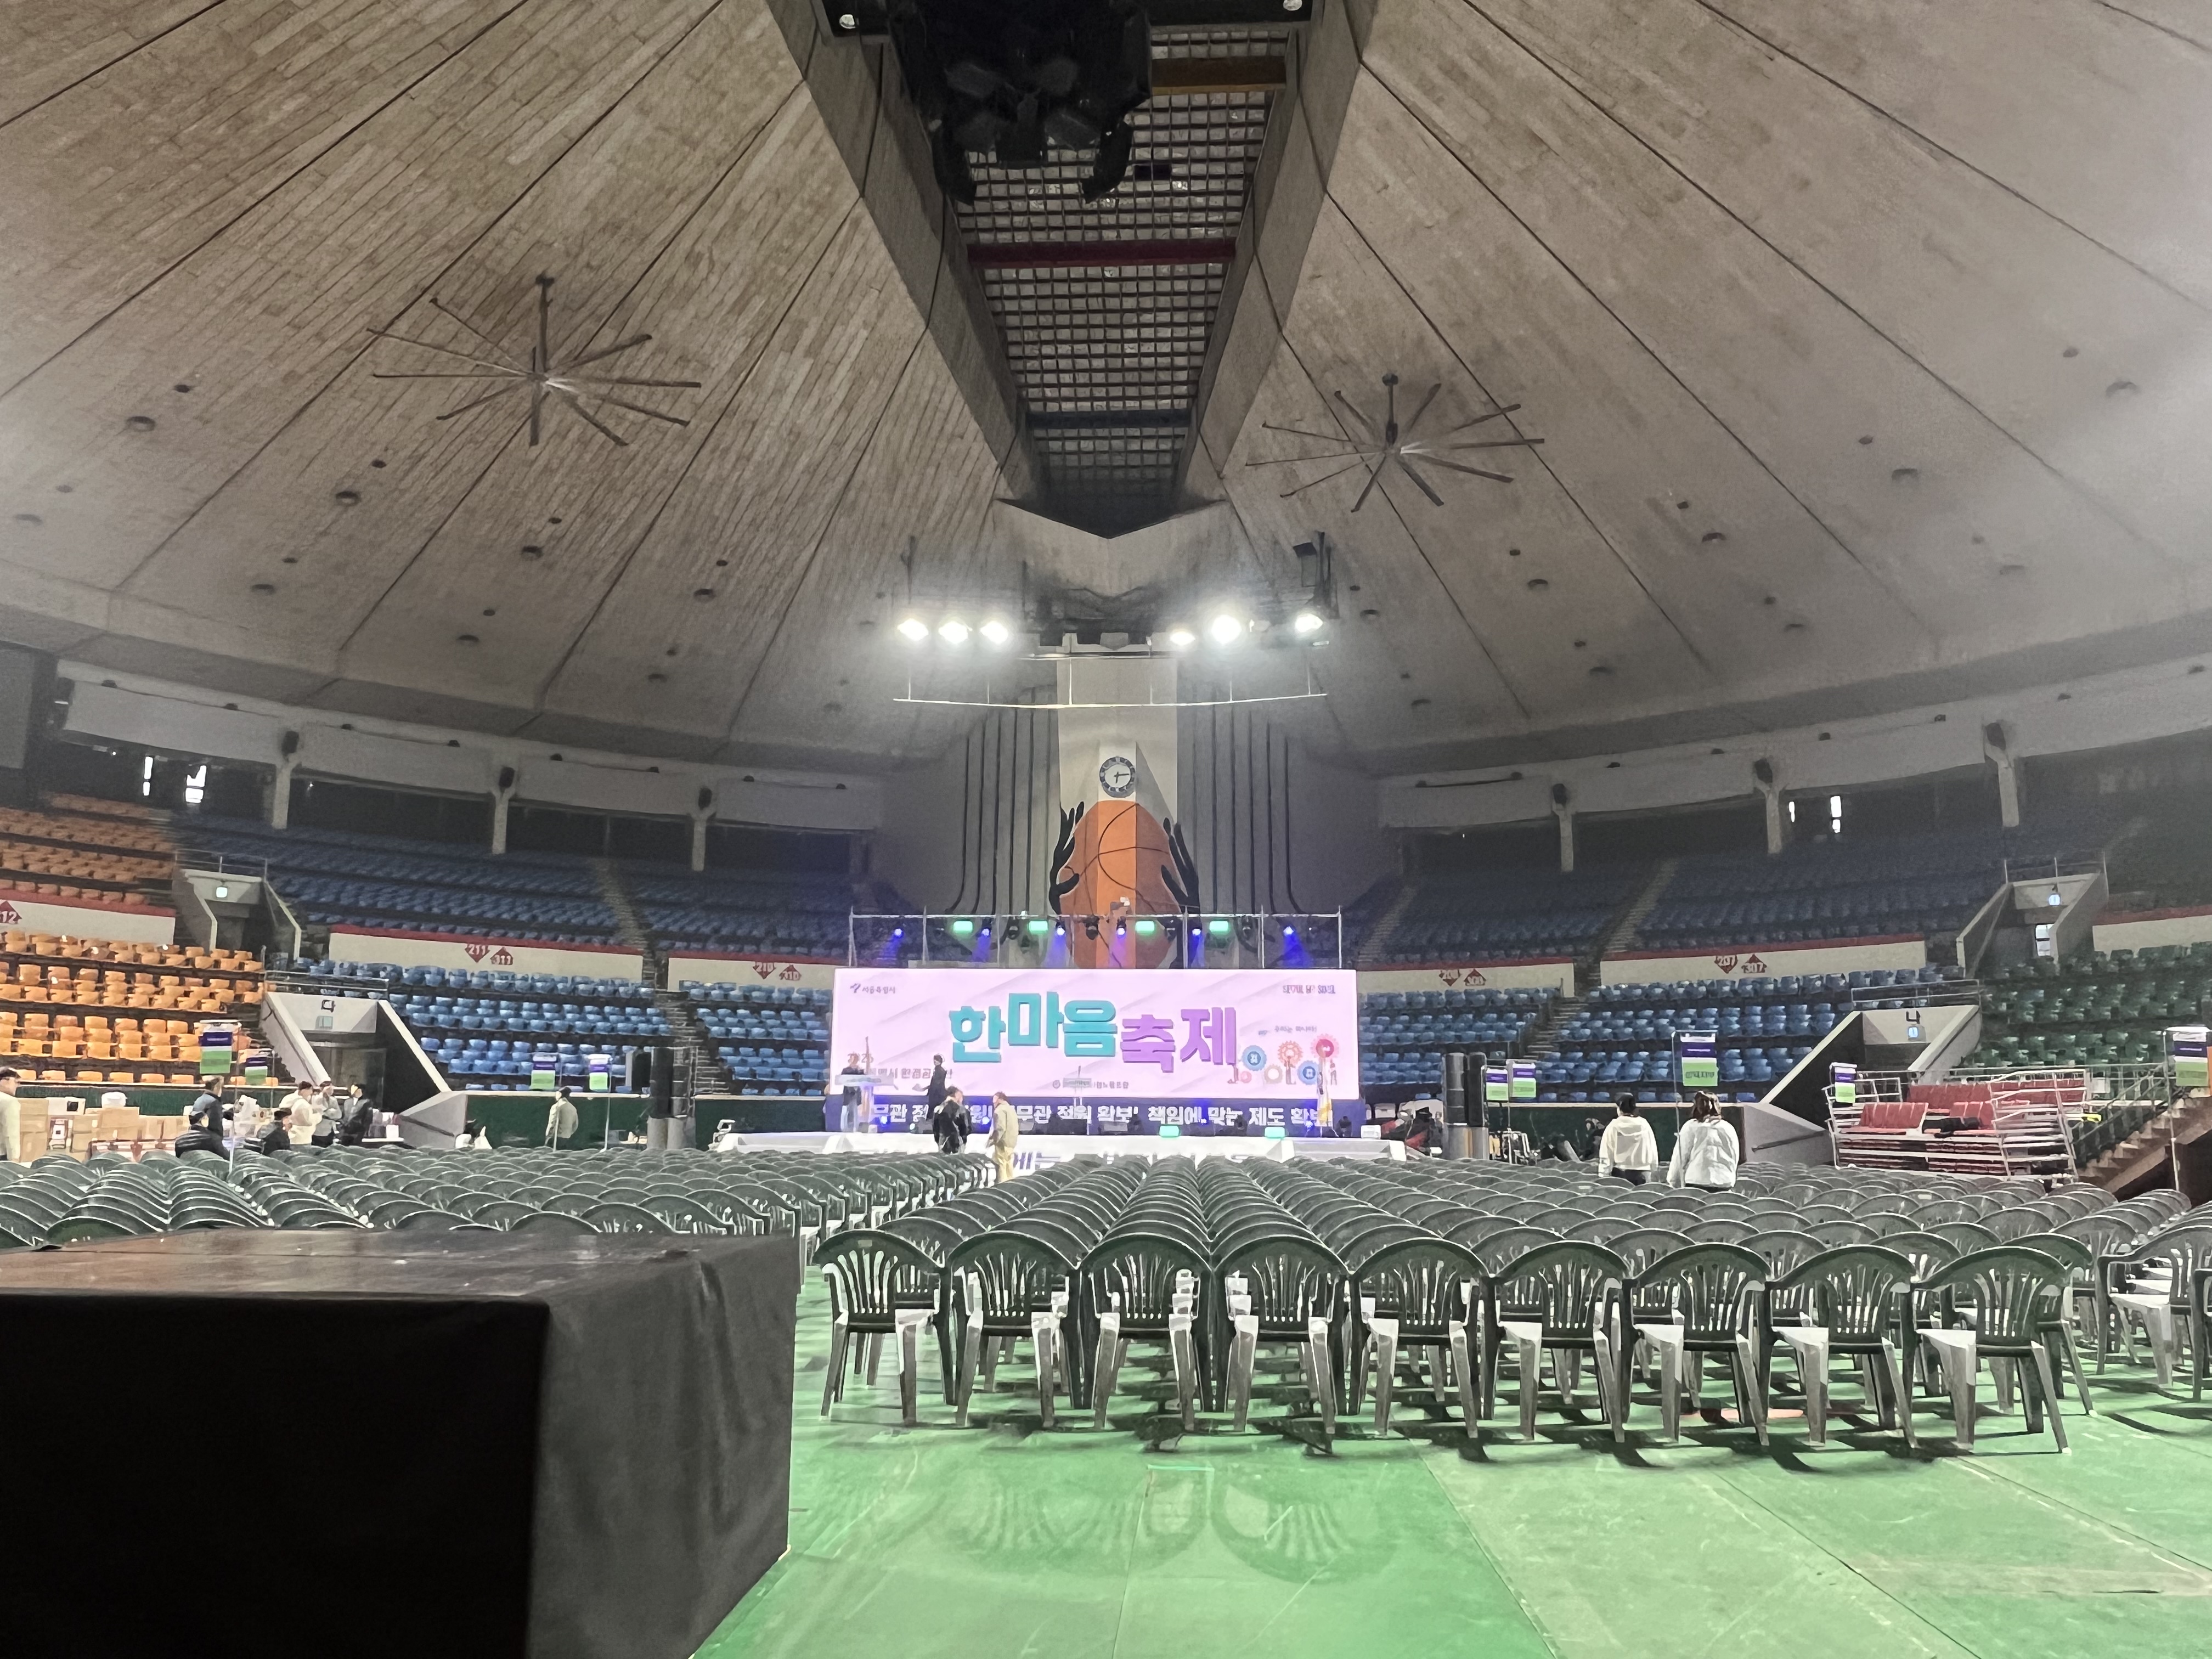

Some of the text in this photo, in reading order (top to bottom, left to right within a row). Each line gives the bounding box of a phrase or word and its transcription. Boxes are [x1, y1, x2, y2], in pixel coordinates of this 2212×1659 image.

[0, 910, 17, 924] 12
[1148, 1105, 1202, 1125] 책임에
[1207, 1106, 1243, 1126] 맞는
[1248, 1107, 1285, 1126] 제도
